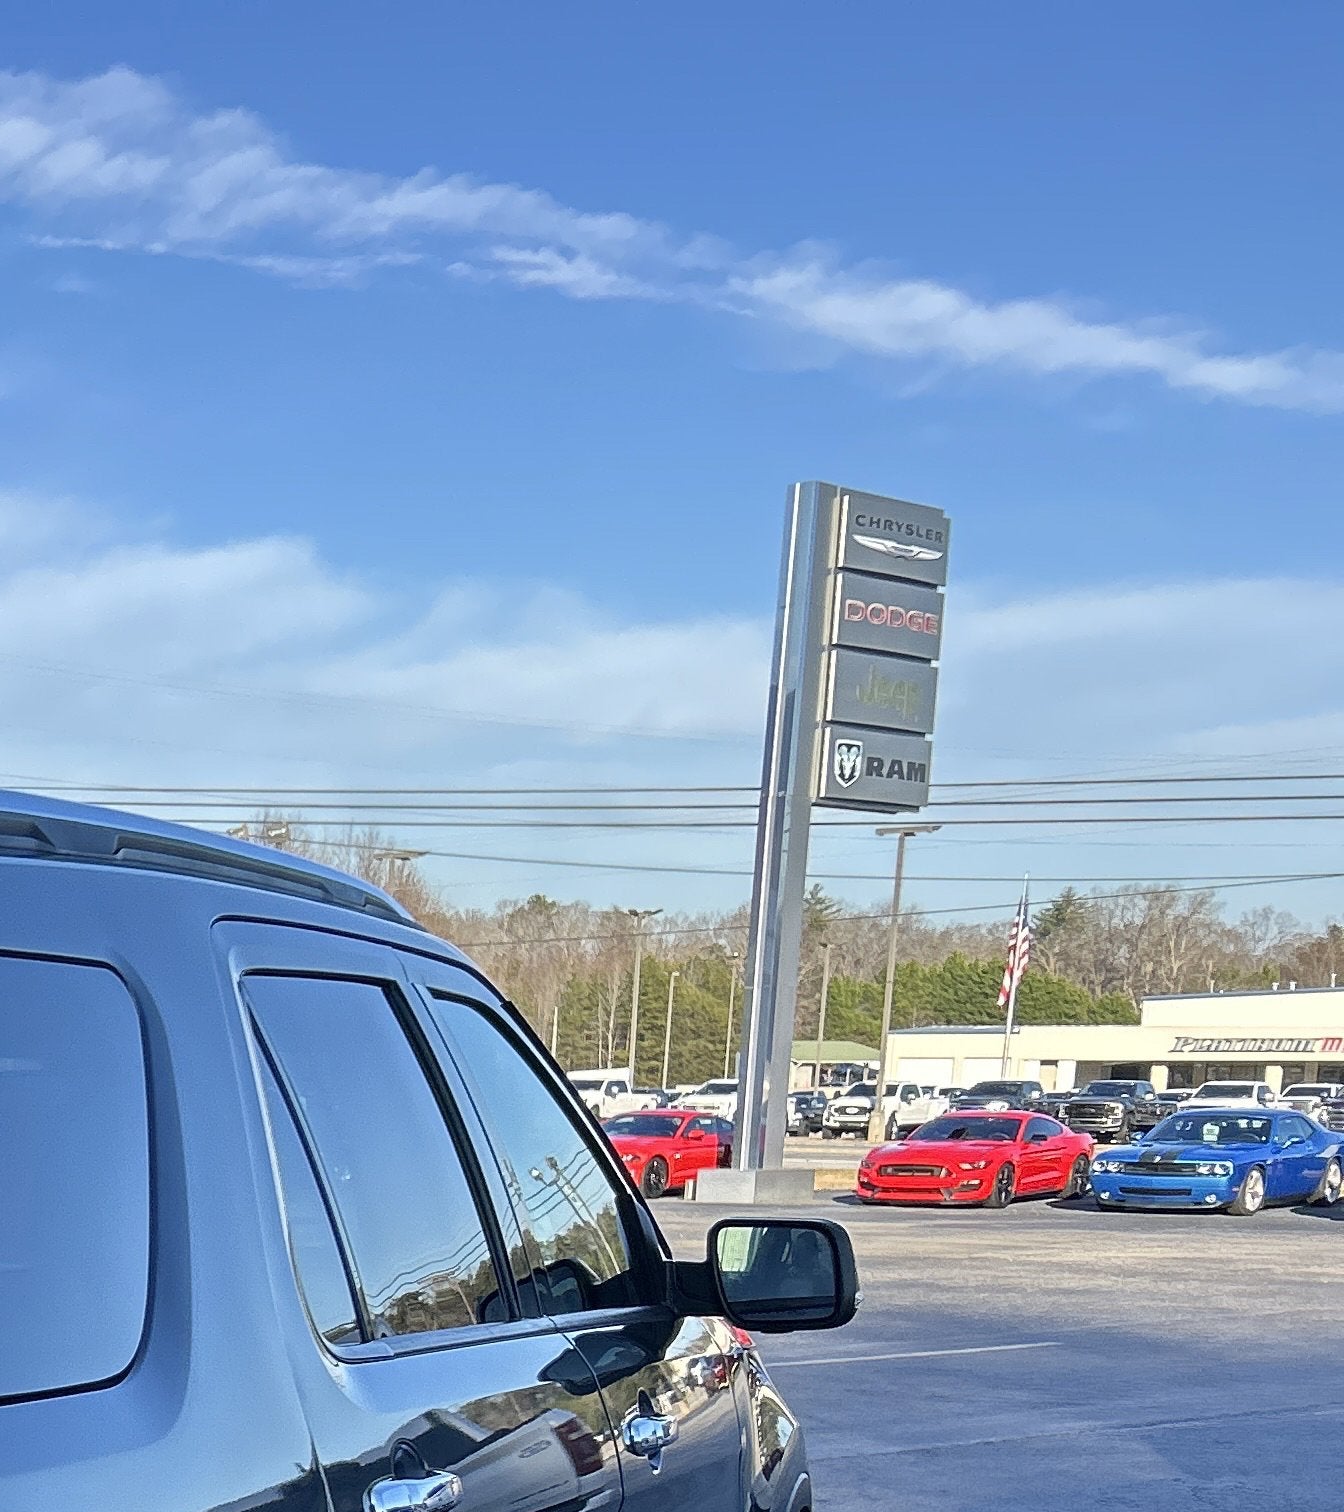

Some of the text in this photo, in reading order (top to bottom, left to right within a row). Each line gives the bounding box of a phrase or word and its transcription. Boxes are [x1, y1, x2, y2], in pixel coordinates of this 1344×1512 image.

[855, 514, 943, 544] CHRYSLER
[844, 599, 940, 635] DODGE
[865, 756, 926, 783] RAM
